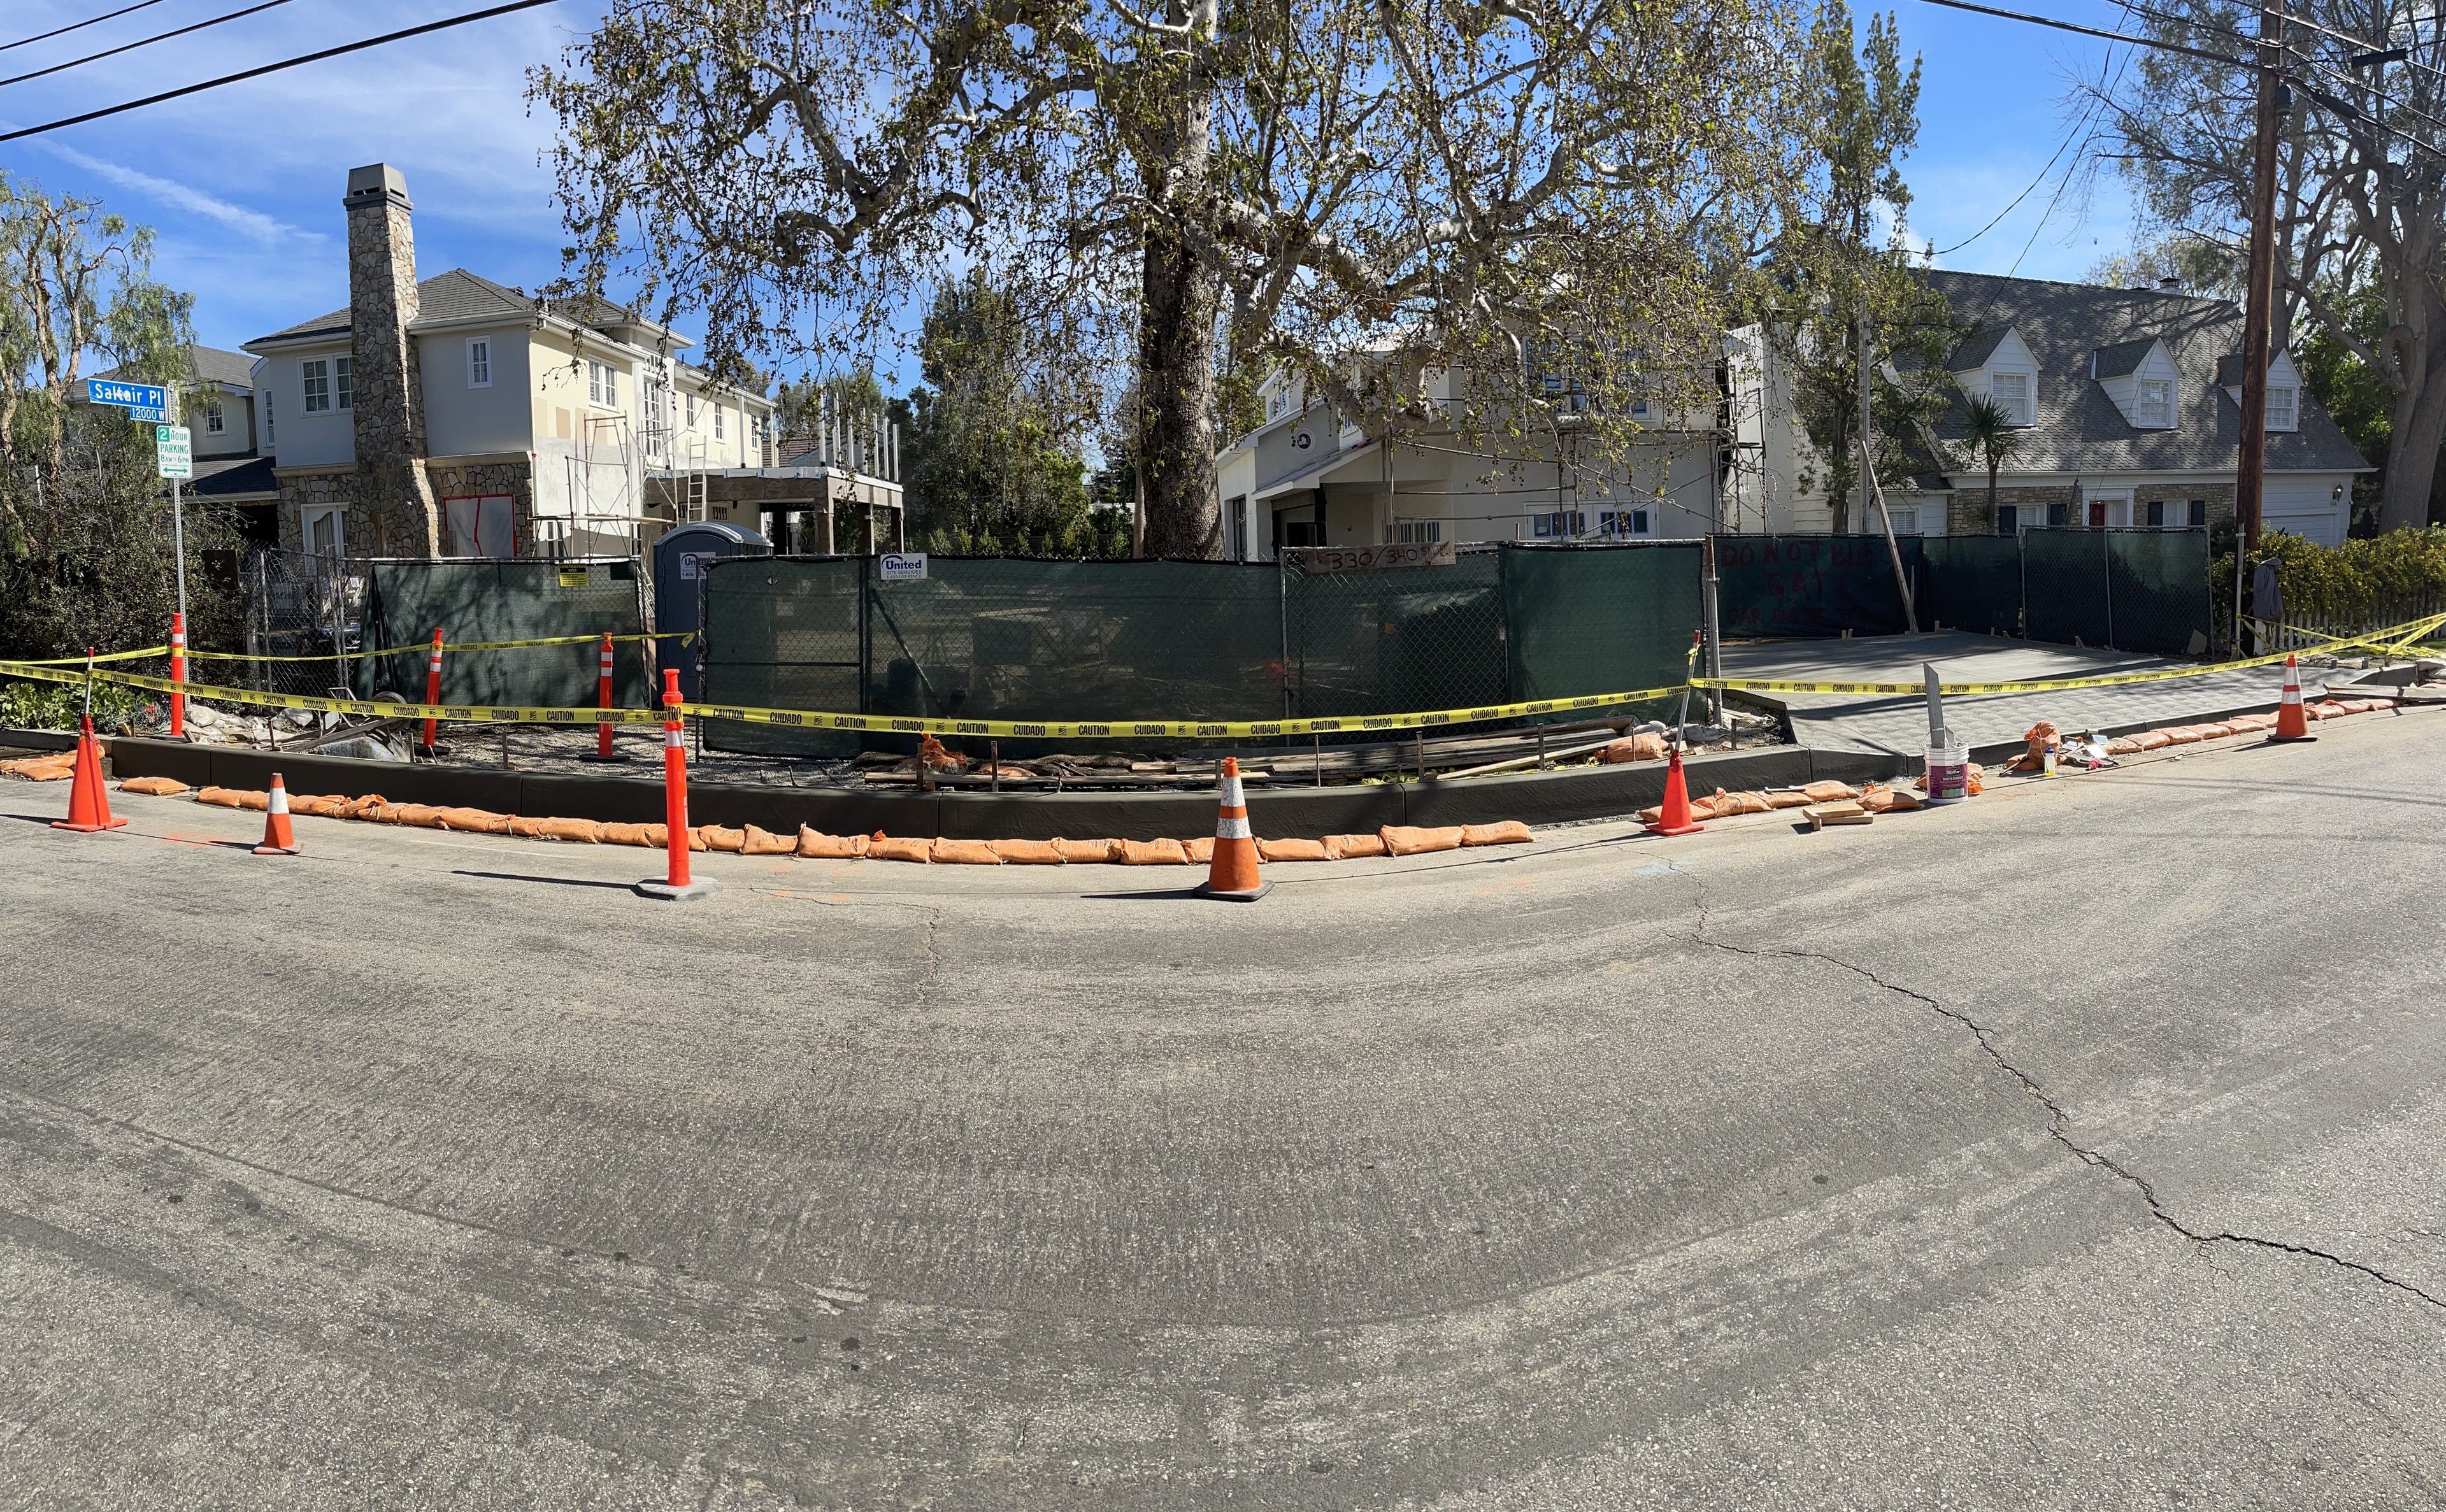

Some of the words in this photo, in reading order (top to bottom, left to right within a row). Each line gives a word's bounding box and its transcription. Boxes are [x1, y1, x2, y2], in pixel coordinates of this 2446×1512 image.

[95, 383, 143, 403] Saltair
[149, 390, 161, 406] Pl
[132, 408, 157, 420] 12000
[158, 411, 165, 420] W
[159, 428, 168, 440] 2
[171, 432, 188, 441] HOUR
[160, 443, 189, 454] PARKING
[1720, 543, 1756, 568] DO
[1763, 540, 1824, 566] NOT
[1830, 541, 1908, 569] BLOC
[886, 559, 922, 569] United
[1703, 681, 1727, 690] CAUTION
[1745, 681, 1770, 691] CUIDADO
[1793, 683, 1816, 692] CAUTION
[1833, 683, 1855, 693] CUIDADO
[1875, 684, 1896, 694] CAUTION
[1910, 685, 1927, 694] CUIDA
[1950, 685, 1970, 693] CAUTION
[1983, 684, 2003, 692] CUIDADO
[2019, 683, 2038, 691] CAUTION
[110, 674, 130, 684] CAUTION
[143, 679, 164, 690] CUIDADO
[183, 685, 204, 696] CAUTION
[218, 690, 242, 701] CUIDADO
[262, 695, 286, 706] CAUTION
[303, 699, 327, 710] CUIDADO
[350, 703, 375, 714] CAUTION
[393, 706, 420, 717] CUIDADO
[445, 708, 472, 719] CAUTION
[491, 710, 519, 720] CUIDADO
[547, 711, 575, 722] CAUTION
[595, 711, 626, 722] CUIDADO
[713, 708, 745, 720] CAUTION
[769, 712, 802, 725] CUIDADO
[834, 716, 867, 729] CAUTION
[891, 719, 924, 732] CUIDADO
[957, 722, 989, 734] CAUTION
[1013, 724, 1046, 736] CUIDADO
[1078, 725, 1110, 736] CAUTION
[1134, 724, 1166, 735] CUIDADO
[1197, 725, 1227, 736] CAUTION
[1250, 724, 1281, 734] CUIDADO
[1310, 720, 1340, 731] CAUTION
[1362, 717, 1392, 729] CUIDADO
[1420, 713, 1450, 725] CAUTION
[1471, 708, 1499, 720] CUIDADO
[1526, 702, 1553, 713] CAUTION
[1572, 697, 1599, 708] CUIDADO
[1624, 691, 1649, 701] CAUTION
